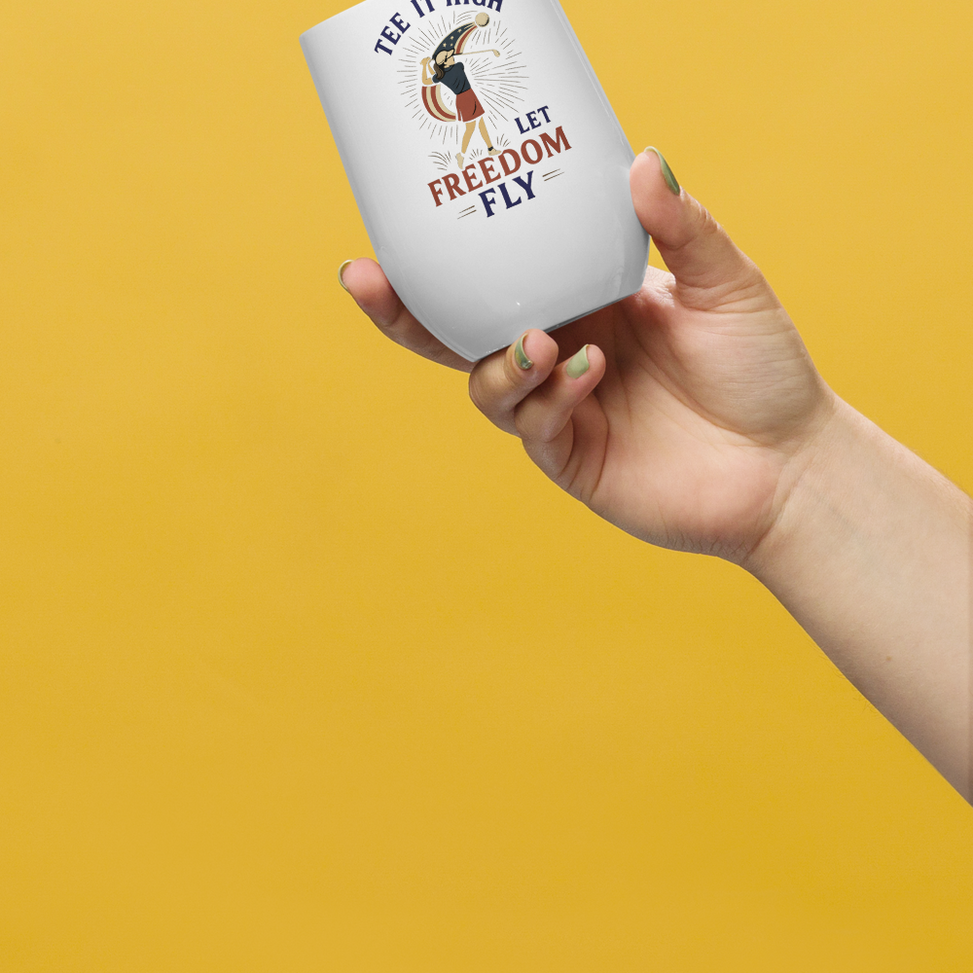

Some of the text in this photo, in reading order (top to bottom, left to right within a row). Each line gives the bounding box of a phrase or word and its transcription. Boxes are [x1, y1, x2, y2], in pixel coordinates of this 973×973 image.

[374, 12, 411, 56] TEE
[514, 105, 551, 135] LET
[427, 125, 572, 207] FREEDOM
[477, 170, 536, 218] FLY
